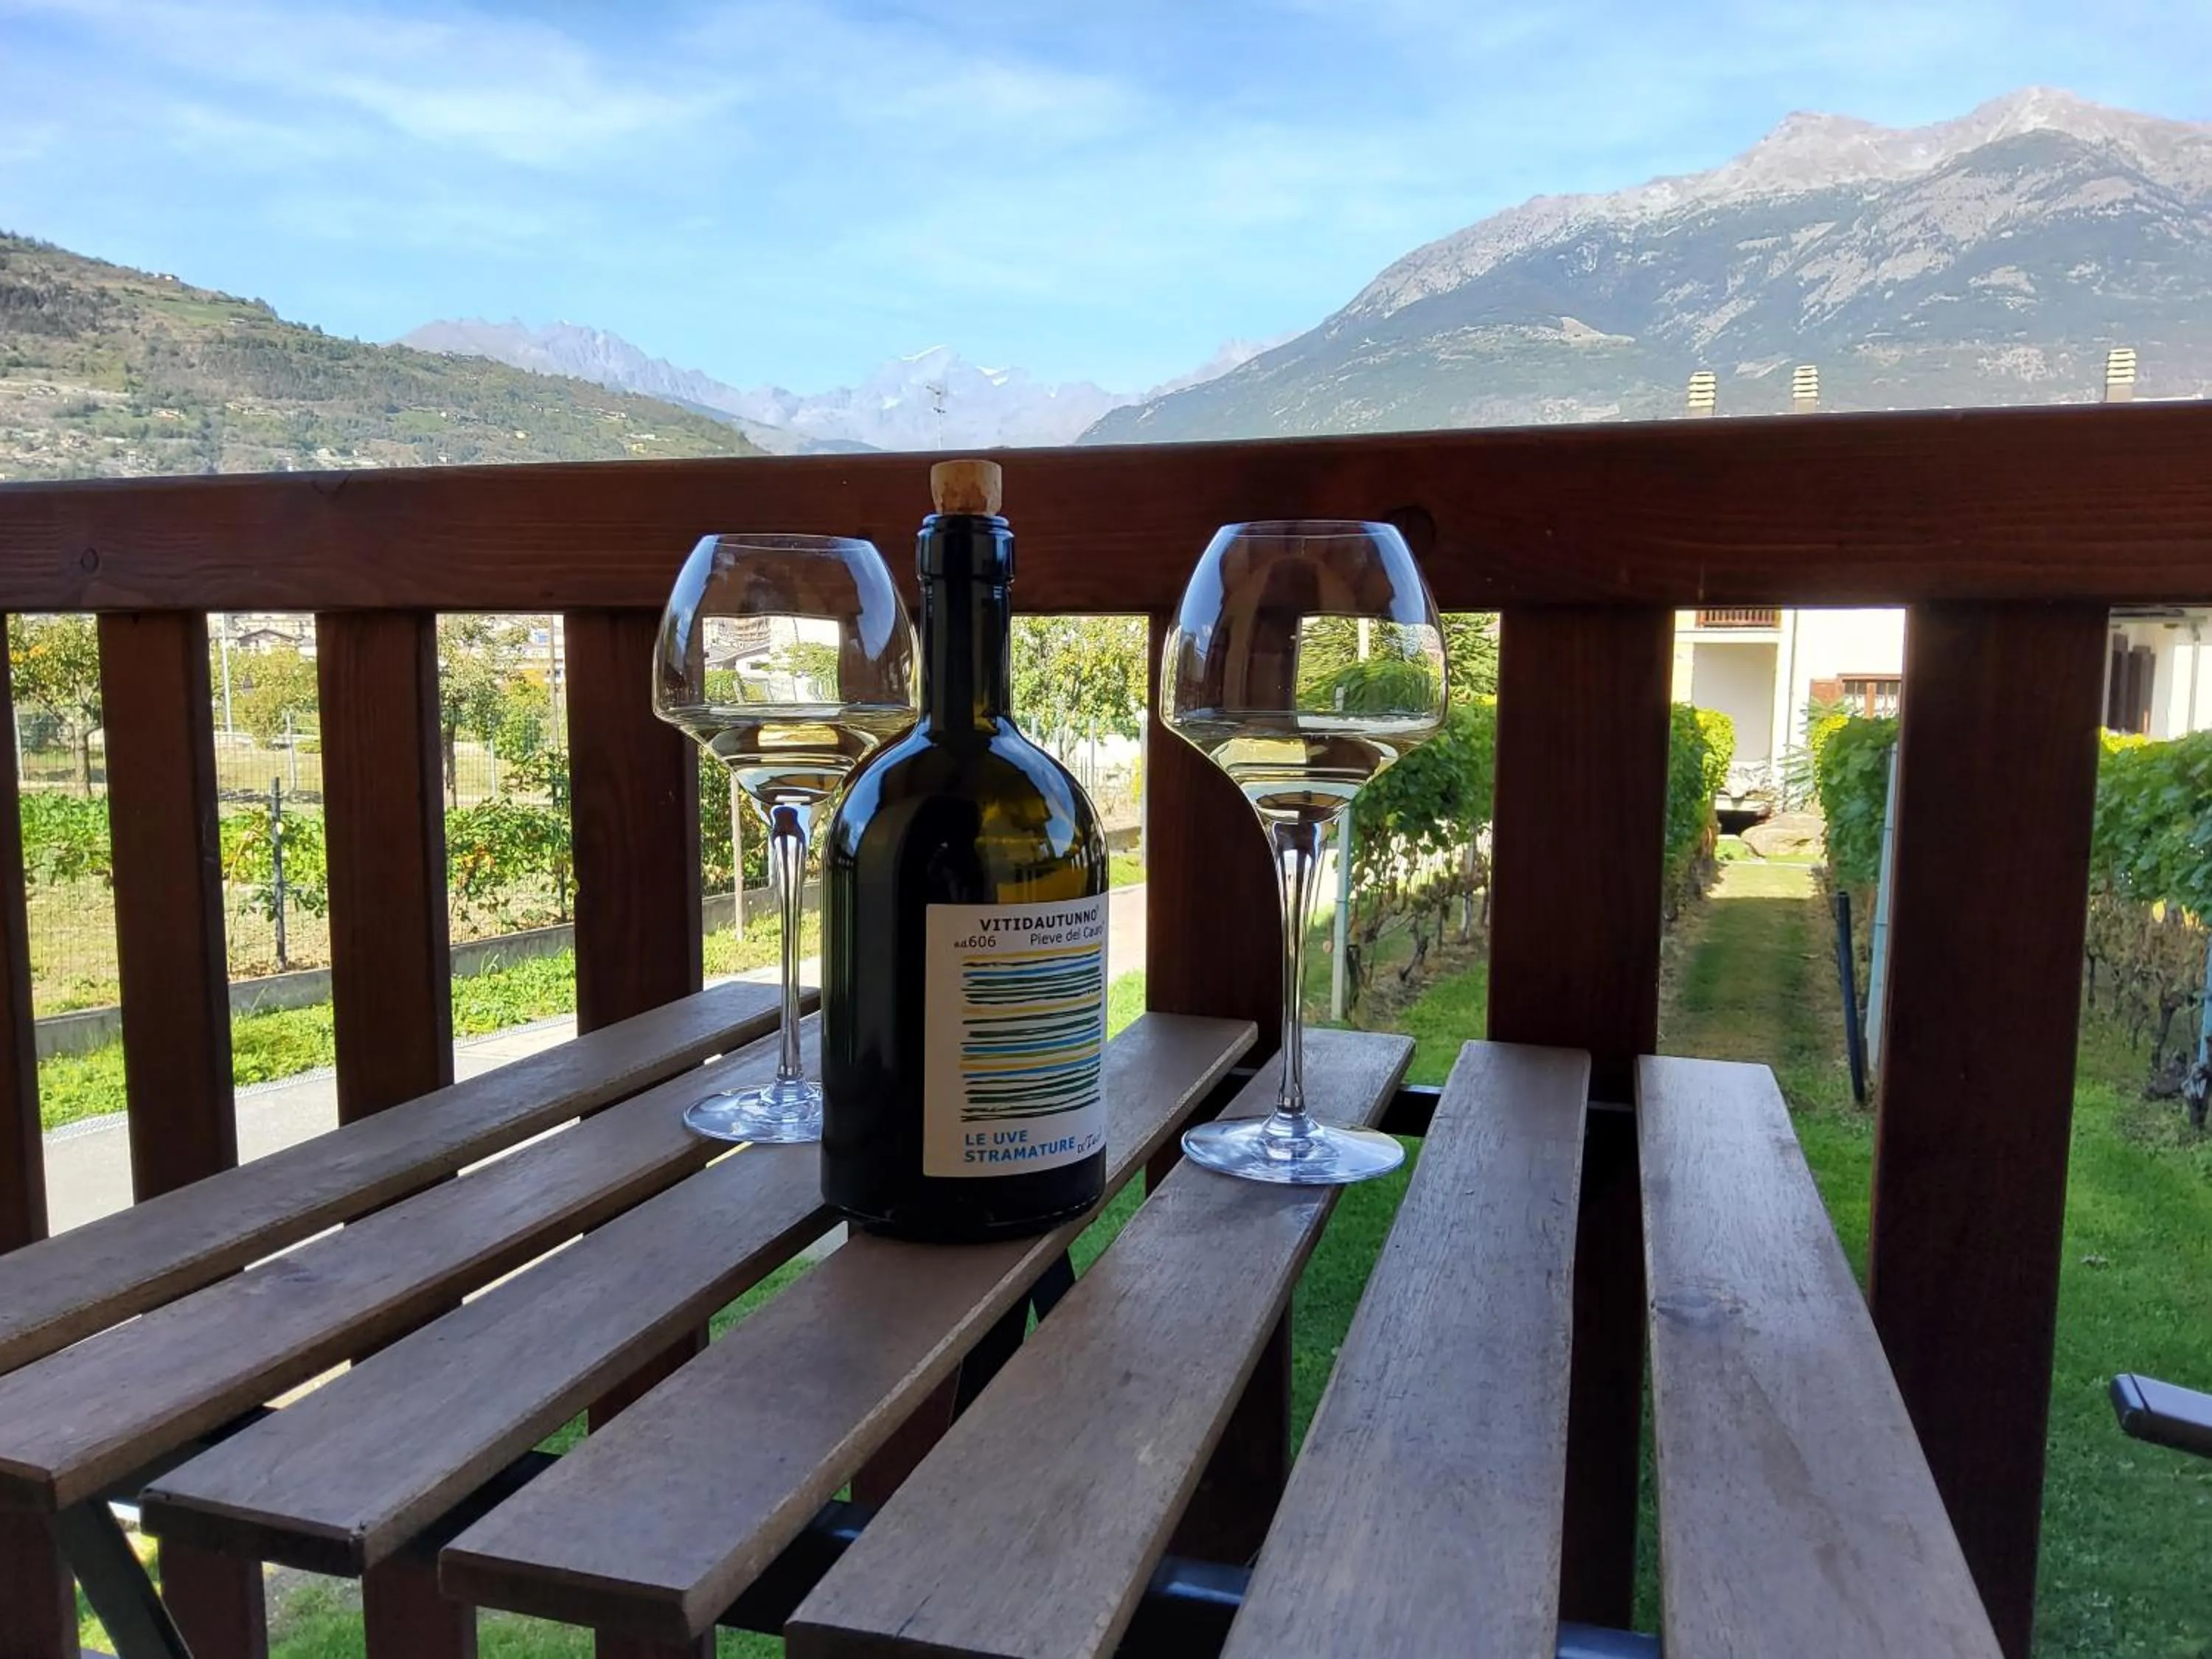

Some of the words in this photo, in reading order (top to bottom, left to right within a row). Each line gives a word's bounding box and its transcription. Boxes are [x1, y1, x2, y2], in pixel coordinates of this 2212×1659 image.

[1030, 932, 1062, 946] Pieve
[1065, 926, 1080, 942] del
[965, 1133, 986, 1146] LE
[993, 1130, 1027, 1144] UVE
[964, 1136, 1075, 1163] STRAMATURE
